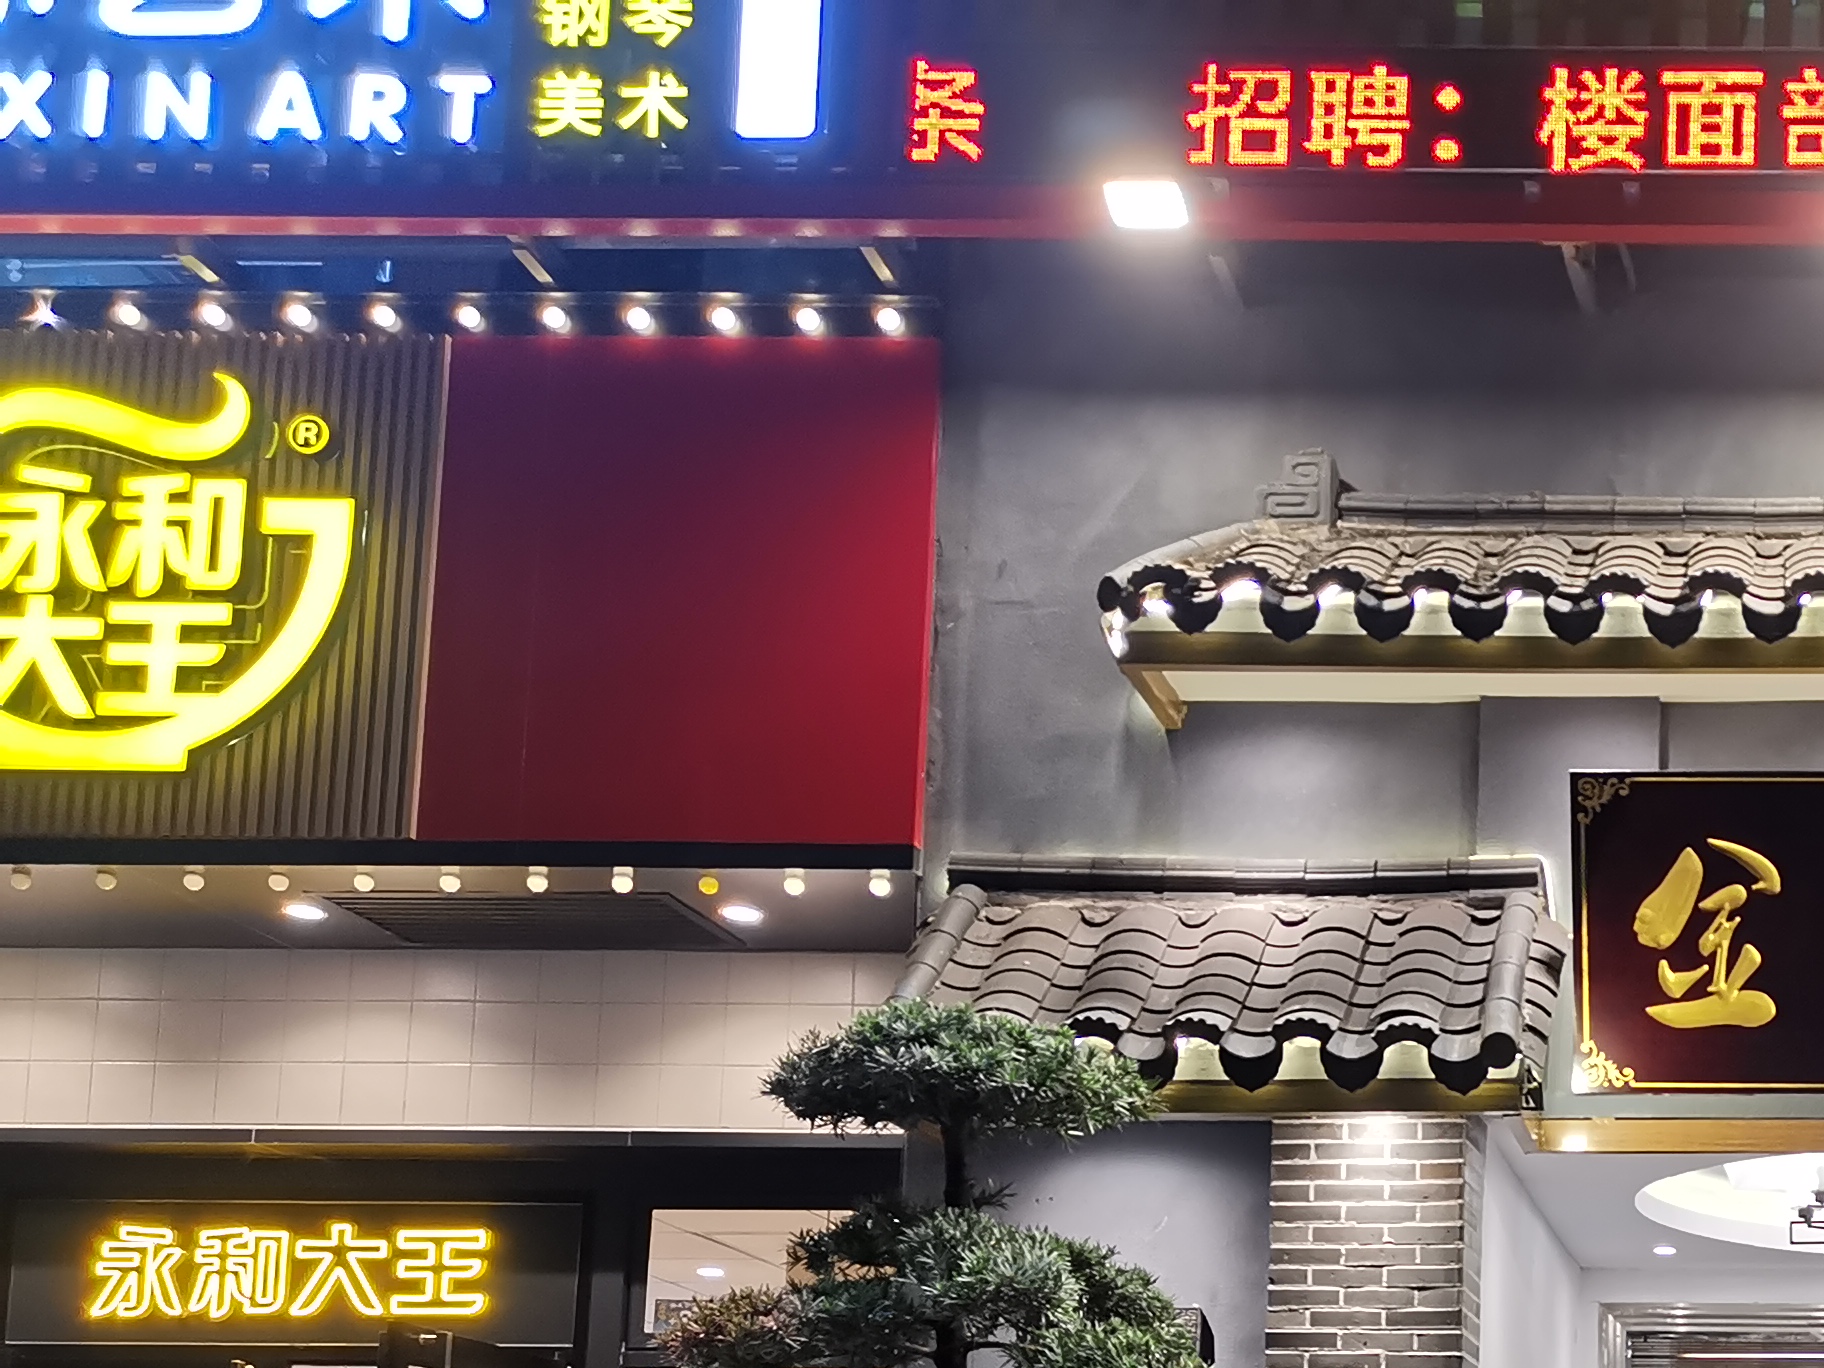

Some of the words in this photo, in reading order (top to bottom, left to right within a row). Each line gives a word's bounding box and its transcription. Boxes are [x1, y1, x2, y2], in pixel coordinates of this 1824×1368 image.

[255, 67, 494, 145] ART
[533, 68, 690, 138] 美术
[87, 1222, 494, 1320] 永和大王
